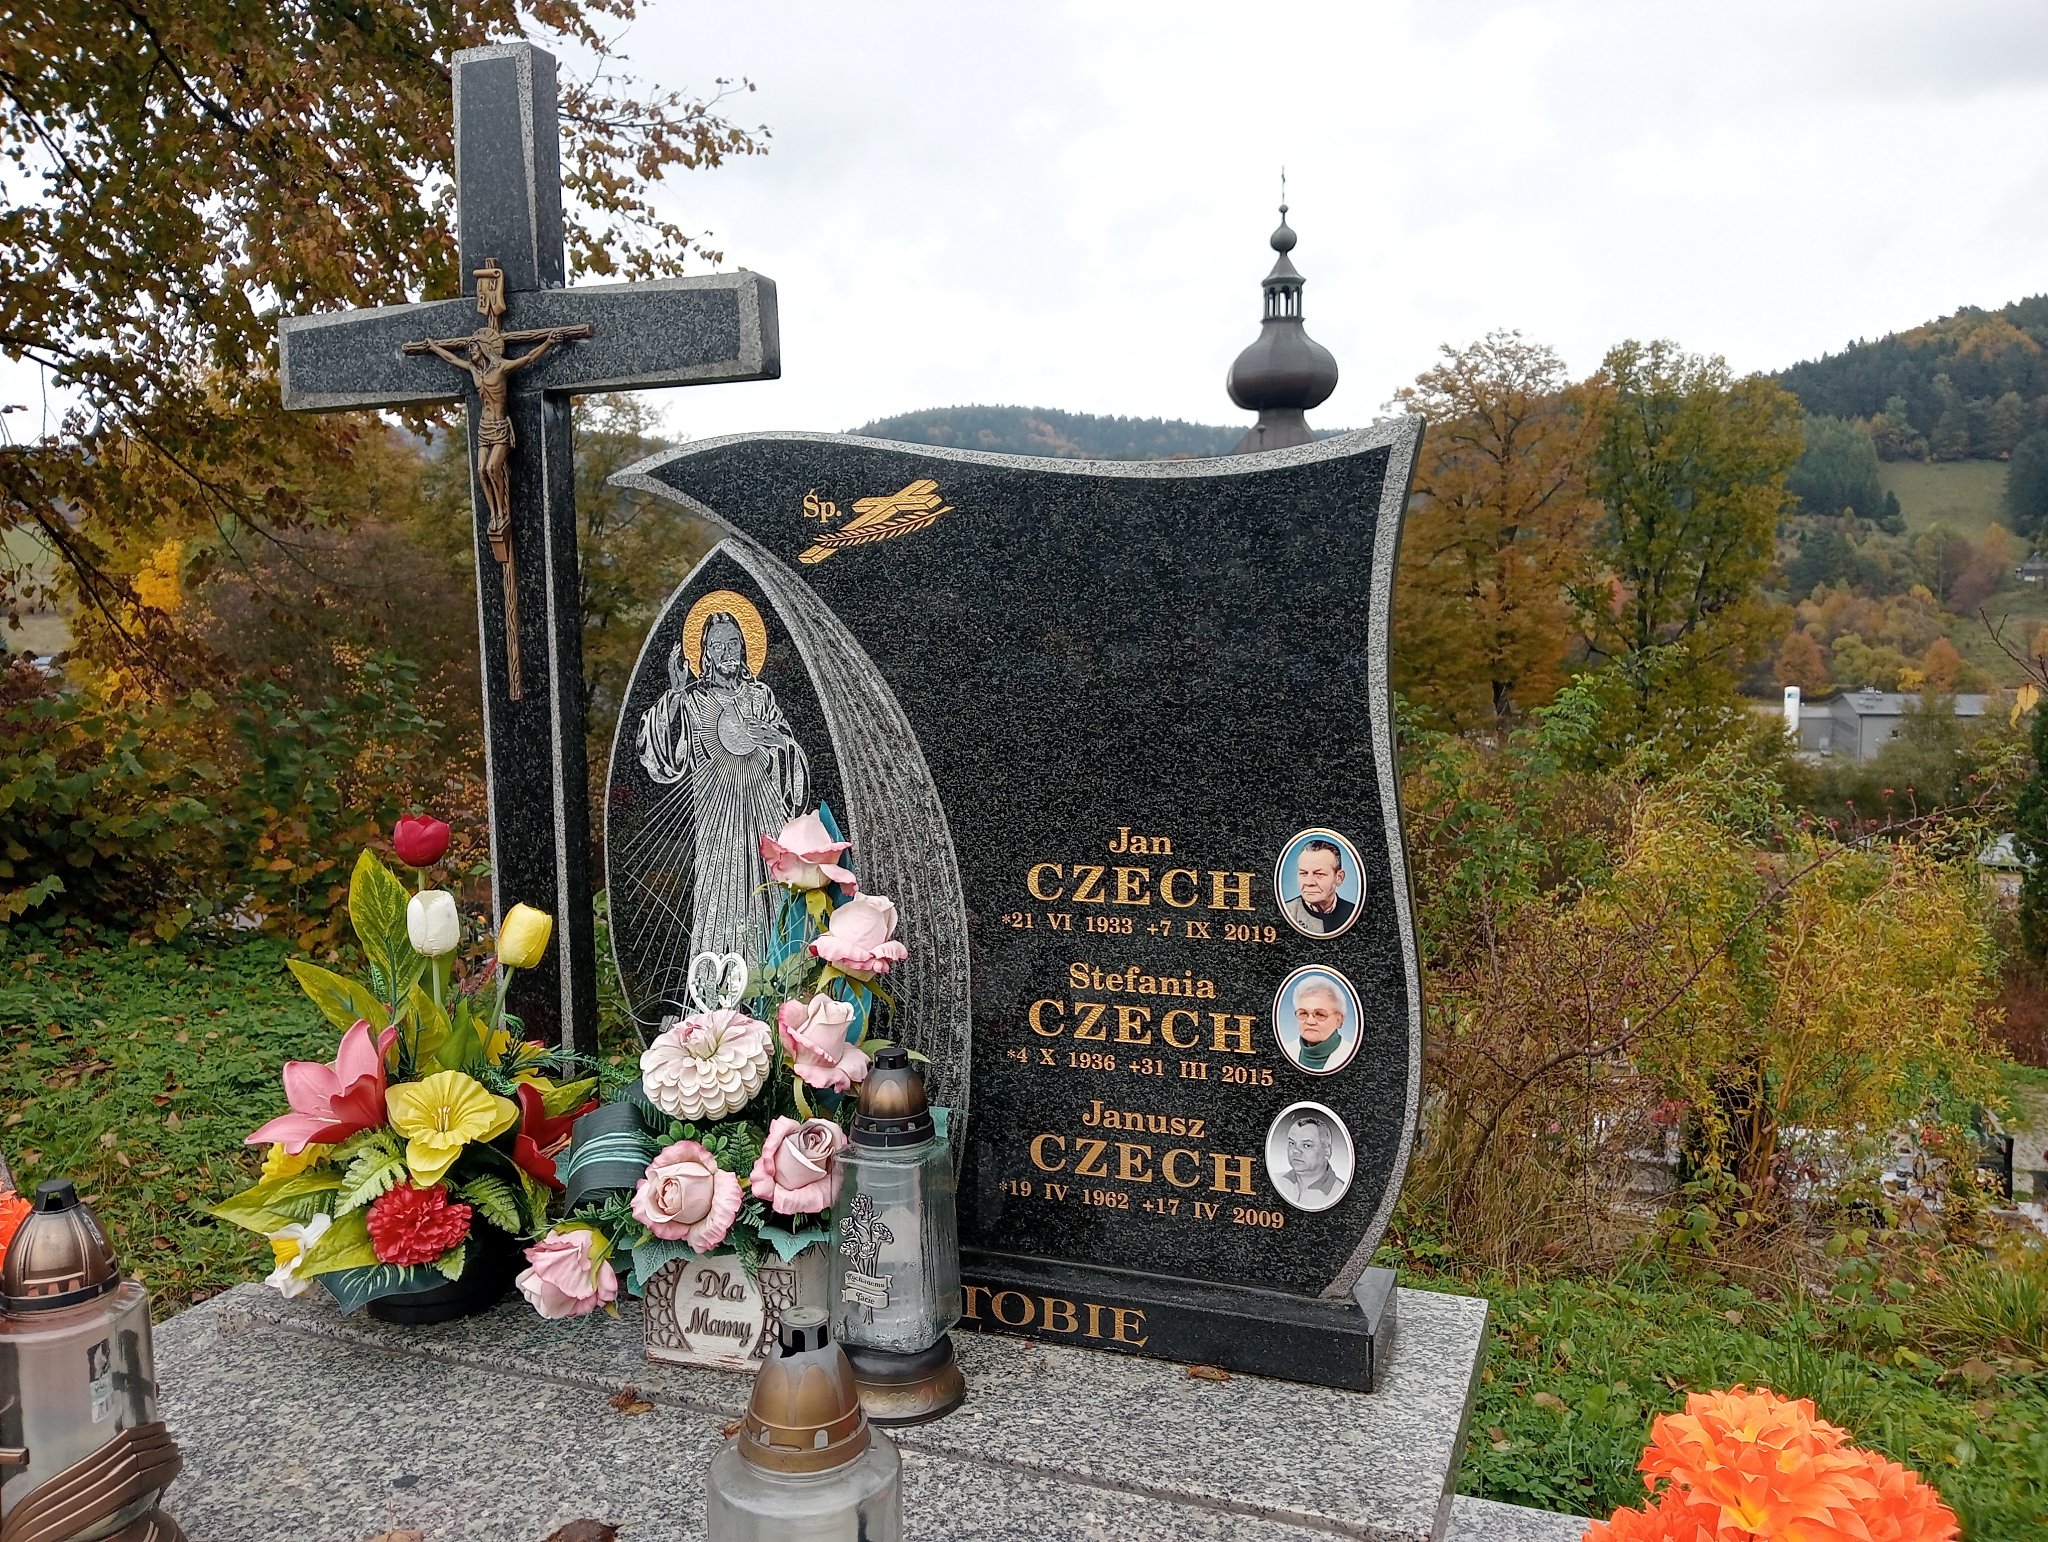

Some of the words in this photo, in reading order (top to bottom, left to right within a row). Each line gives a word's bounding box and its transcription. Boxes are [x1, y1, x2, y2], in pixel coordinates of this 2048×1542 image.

[803, 488, 842, 523] Śp.
[1109, 827, 1173, 855] Jan
[1026, 862, 1256, 911] CZECH
[1046, 912, 1073, 931] VI
[1085, 915, 1133, 935] 1933
[1185, 920, 1211, 939] IX
[1223, 923, 1277, 943] 2019
[1069, 962, 1217, 999] Stefania
[1028, 999, 1257, 1055] CZECH
[1039, 1048, 1056, 1066] X
[1068, 1051, 1116, 1071] 1936
[1179, 1060, 1209, 1080] III
[1221, 1065, 1274, 1087] 2015
[1082, 1100, 1206, 1138] Janusz
[1030, 1133, 1257, 1195] CZECH
[1044, 1183, 1070, 1201] IV
[1082, 1188, 1129, 1209] 1962
[1192, 1201, 1220, 1221] IV
[1232, 1207, 1285, 1229] 2009
[693, 1269, 747, 1303] Dla
[685, 1306, 753, 1348] Mamy
[961, 1285, 1149, 1348] TOBIE
